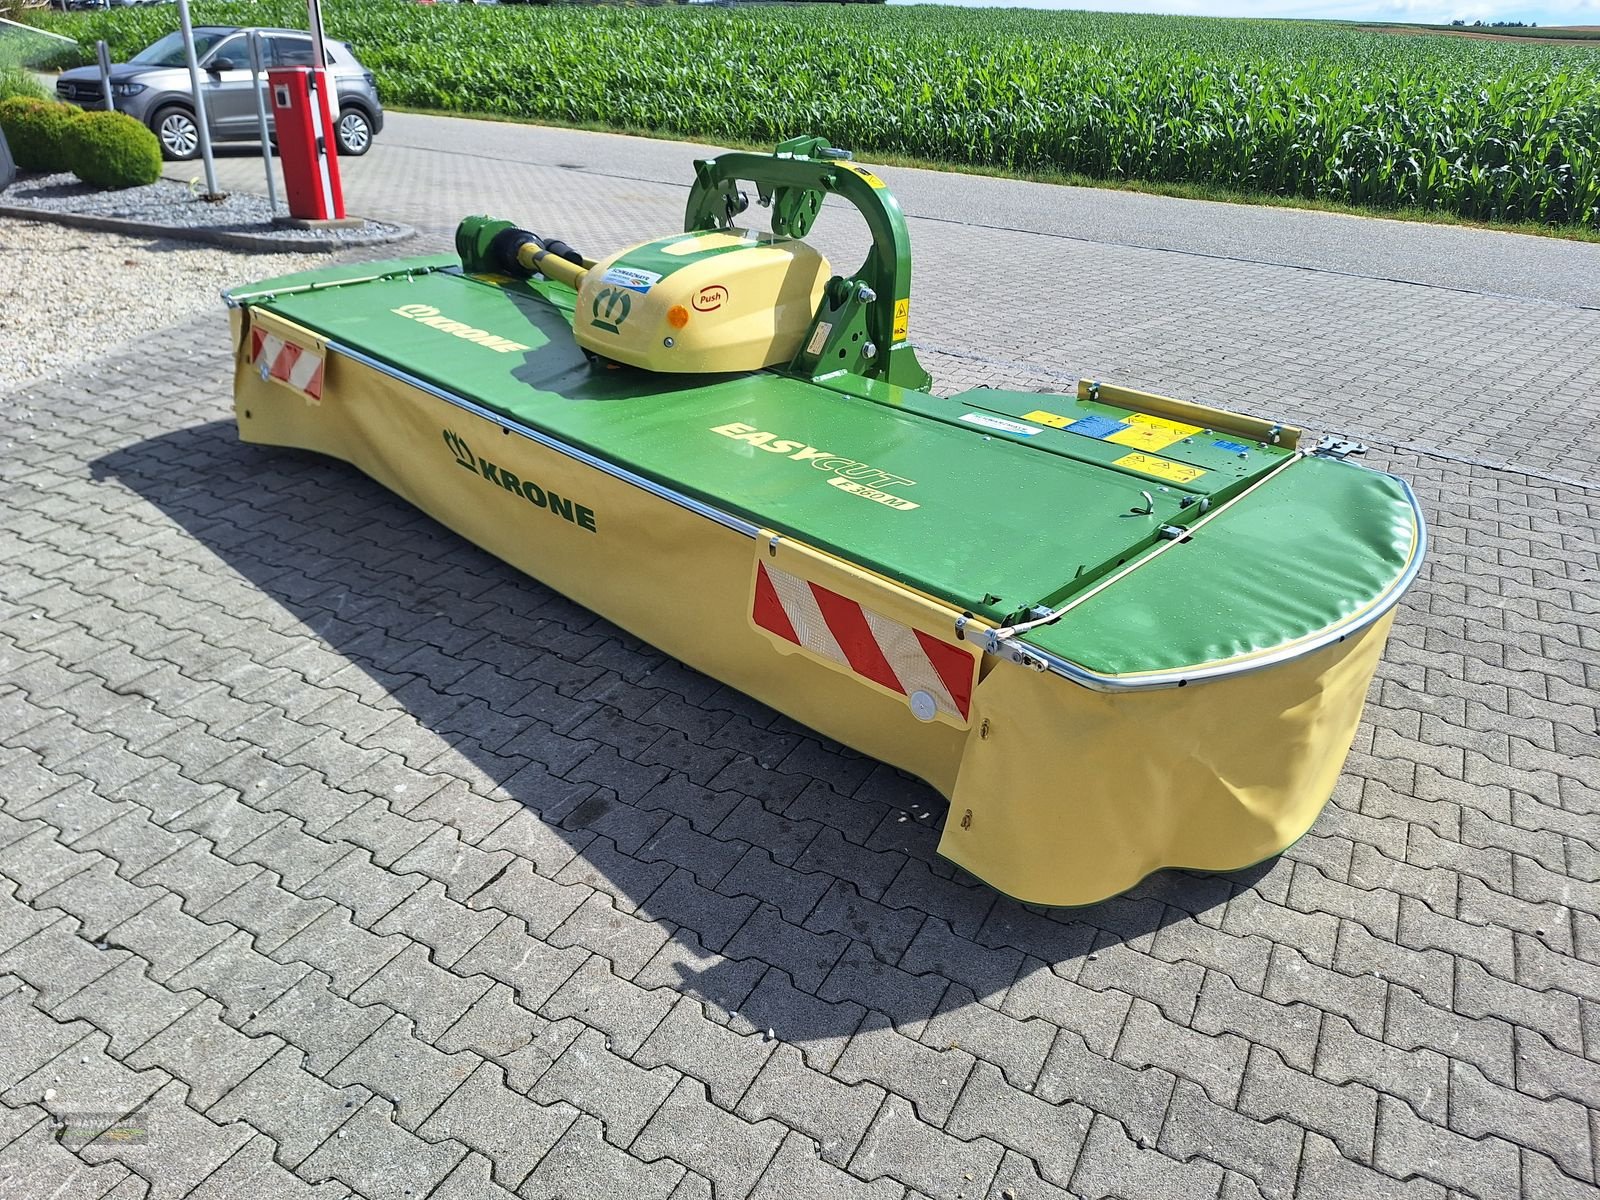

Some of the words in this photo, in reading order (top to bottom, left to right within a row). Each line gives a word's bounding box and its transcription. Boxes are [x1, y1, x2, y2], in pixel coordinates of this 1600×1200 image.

[700, 292, 721, 304] Push
[414, 316, 531, 353] KRONE
[709, 422, 917, 489] EASYCUT
[478, 457, 597, 533] KRONE
[849, 486, 886, 499] 360
[883, 498, 908, 507] M
